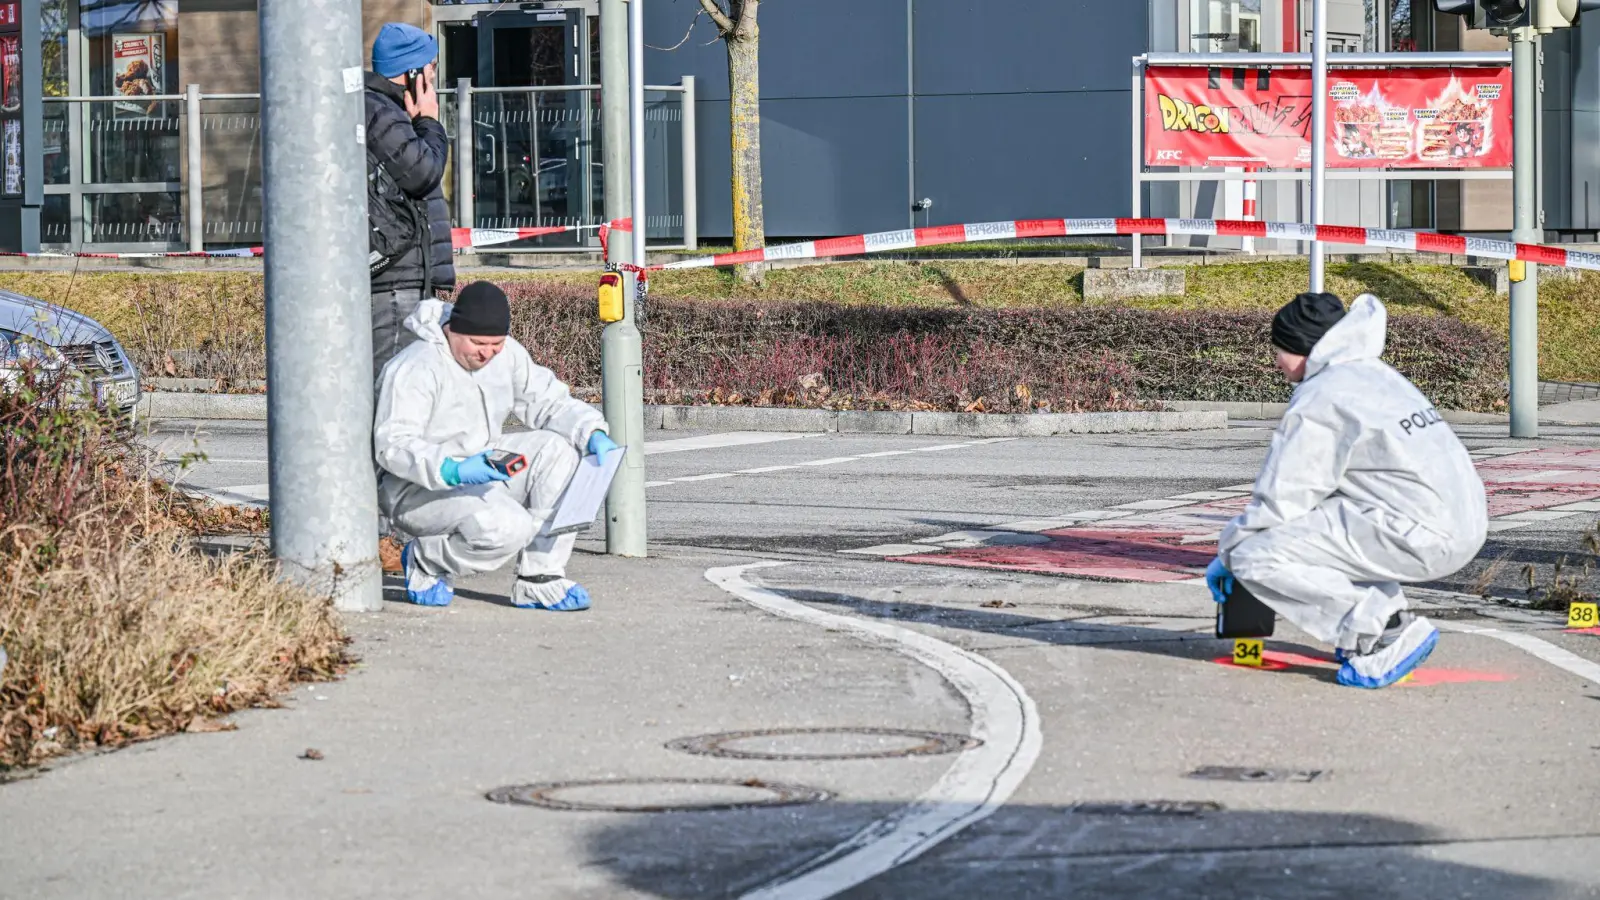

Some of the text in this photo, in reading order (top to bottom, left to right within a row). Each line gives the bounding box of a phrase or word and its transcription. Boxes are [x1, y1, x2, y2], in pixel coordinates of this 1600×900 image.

[1156, 150, 1183, 161] KFC
[1571, 607, 1592, 622] 38
[1234, 643, 1260, 660] 34
